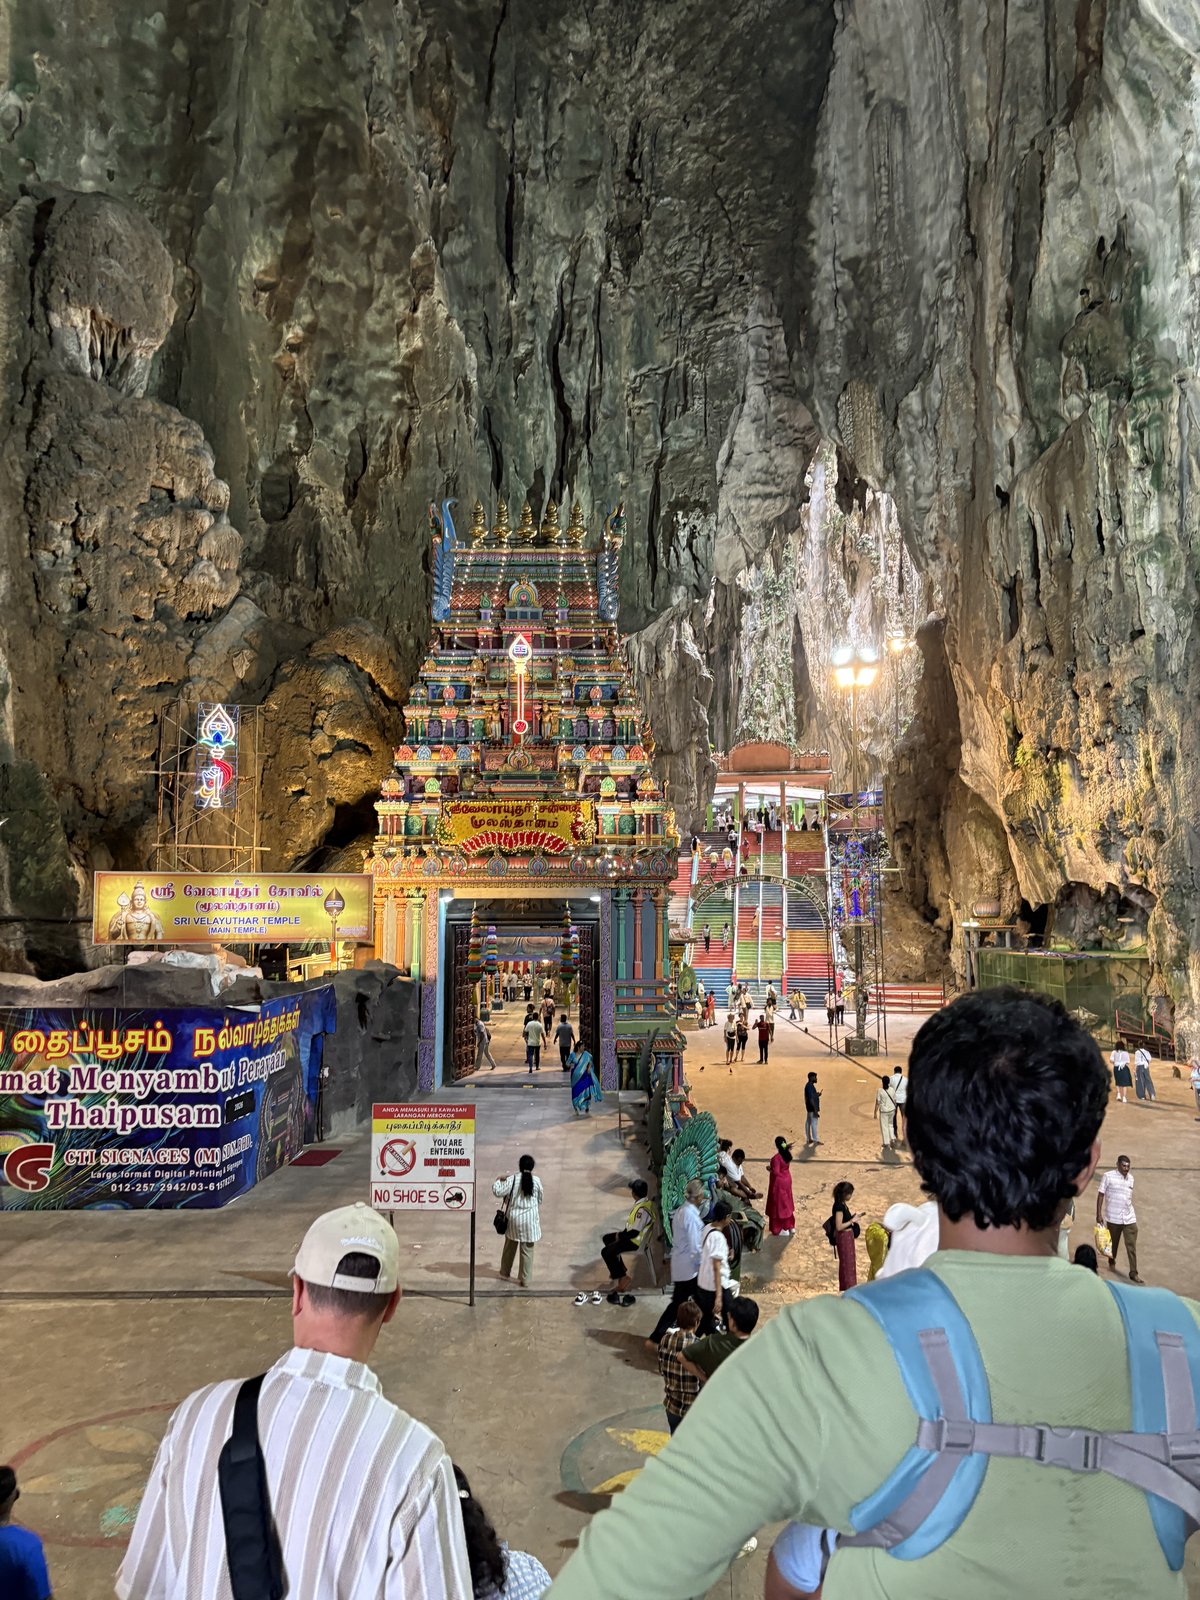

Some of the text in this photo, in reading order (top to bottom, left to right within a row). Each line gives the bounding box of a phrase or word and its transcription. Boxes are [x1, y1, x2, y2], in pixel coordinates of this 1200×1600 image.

[183, 885, 260, 899] வேலாயுதர்
[268, 884, 324, 898] கோவில்
[173, 916, 301, 926] SRI VELAYUTHAR TEMPLE
[207, 927, 268, 935] (MAIN TEMPLE)
[12, 1020, 173, 1060] தைப்பூசம்
[68, 1061, 235, 1098] Menyambut
[45, 1098, 221, 1134] Thaipusam
[433, 1138, 462, 1146] YOU ARE
[64, 1148, 96, 1166] CTI
[101, 1148, 190, 1166] SIGNAGES
[194, 1147, 221, 1167] (M)
[430, 1147, 465, 1156] ENTERING
[91, 1171, 118, 1180] Large
[121, 1170, 151, 1178] format
[154, 1170, 186, 1179] Digital
[110, 1183, 155, 1192] 012-257
[374, 1190, 439, 1203] NO SHOES
